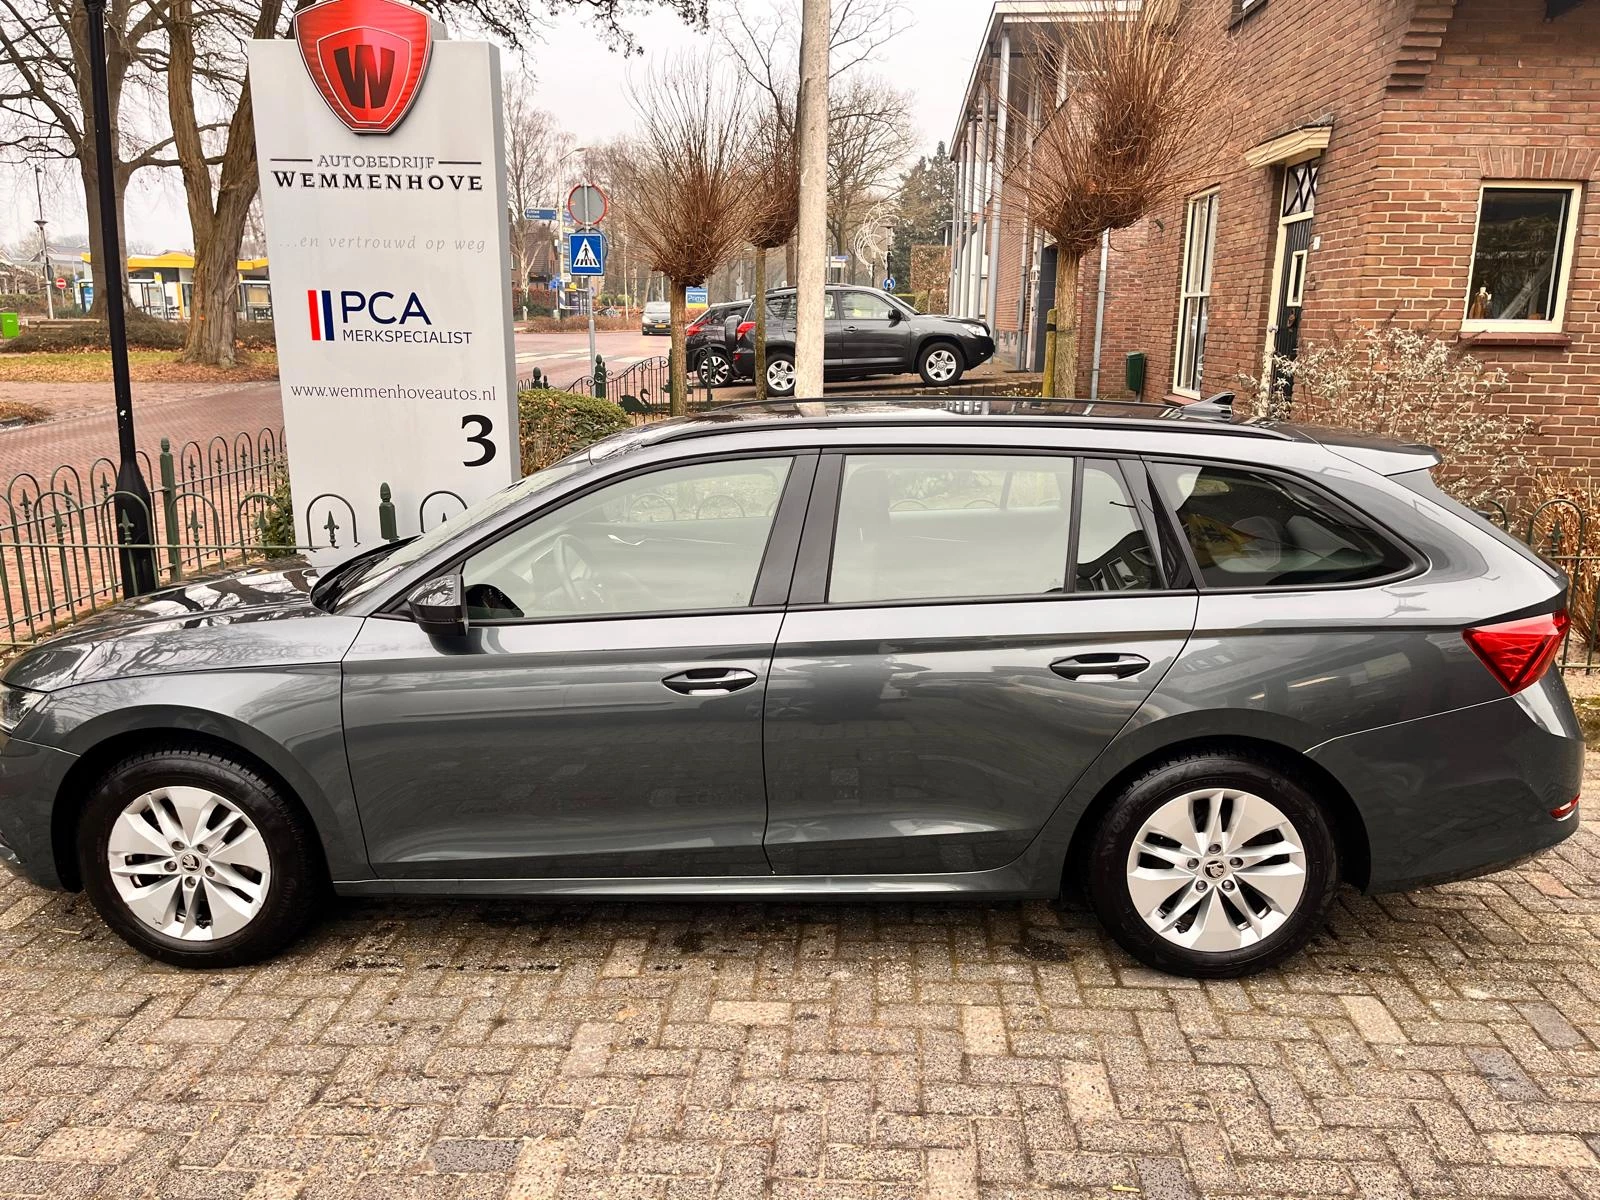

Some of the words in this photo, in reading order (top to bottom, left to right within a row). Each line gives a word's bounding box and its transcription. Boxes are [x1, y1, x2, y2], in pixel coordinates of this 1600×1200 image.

[333, 44, 396, 110] W
[316, 154, 436, 170] AUTOBEDRIJF
[270, 170, 484, 191] WEMMENHOVE
[328, 235, 417, 250] vertrouwd
[425, 237, 445, 254] op
[454, 238, 486, 254] weg
[340, 290, 433, 326] PCA
[342, 328, 473, 345] MERKSPECIALIST
[290, 383, 497, 402] www.wemmenhoveautos.nl
[460, 413, 497, 468] 3
